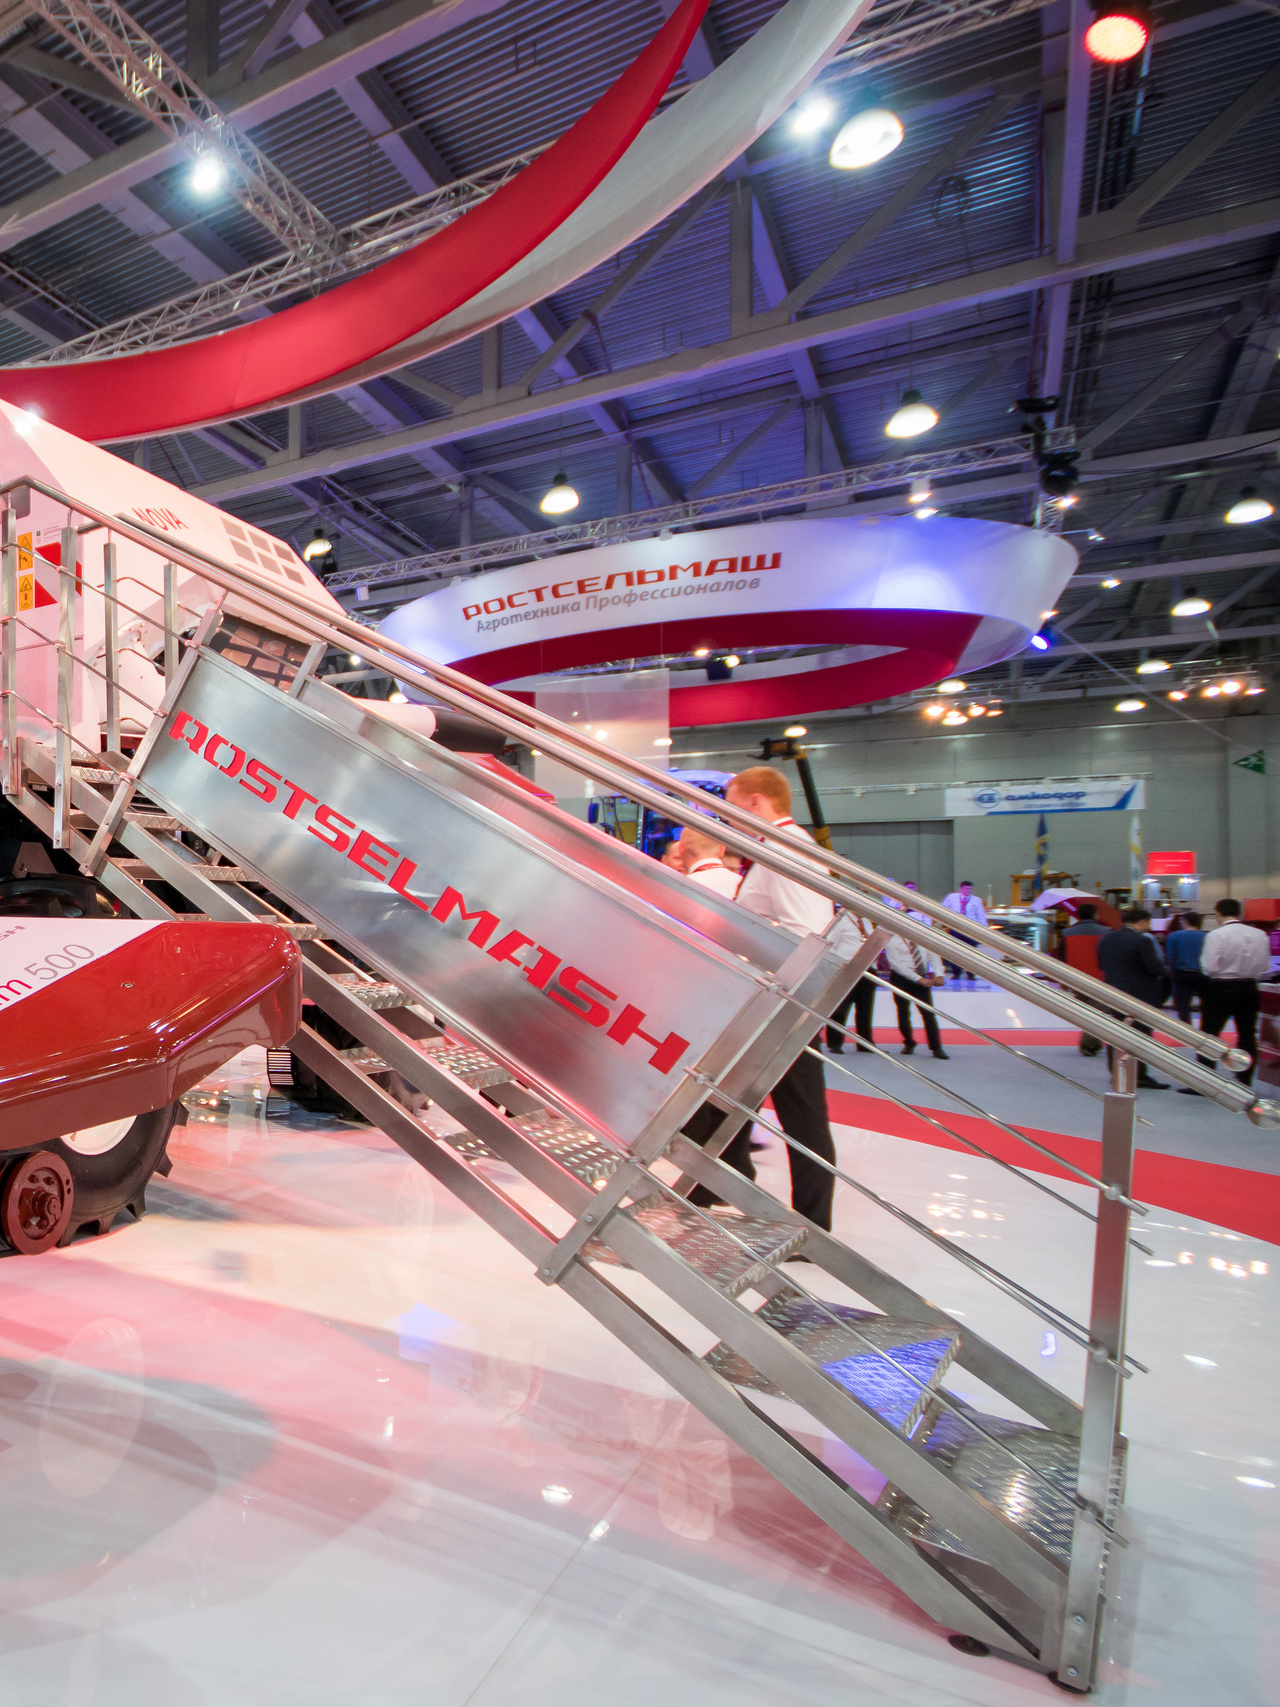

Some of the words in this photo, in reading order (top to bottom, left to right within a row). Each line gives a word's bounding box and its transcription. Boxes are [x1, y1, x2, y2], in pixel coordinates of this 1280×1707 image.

[131, 507, 189, 531] NOVA
[462, 551, 783, 621] РОСТСЕЛЬМАШ
[476, 601, 581, 633] Агротехника
[585, 577, 761, 611] Профессионалов
[167, 709, 691, 1075] ROSTSELMASH
[22, 943, 95, 981] 500
